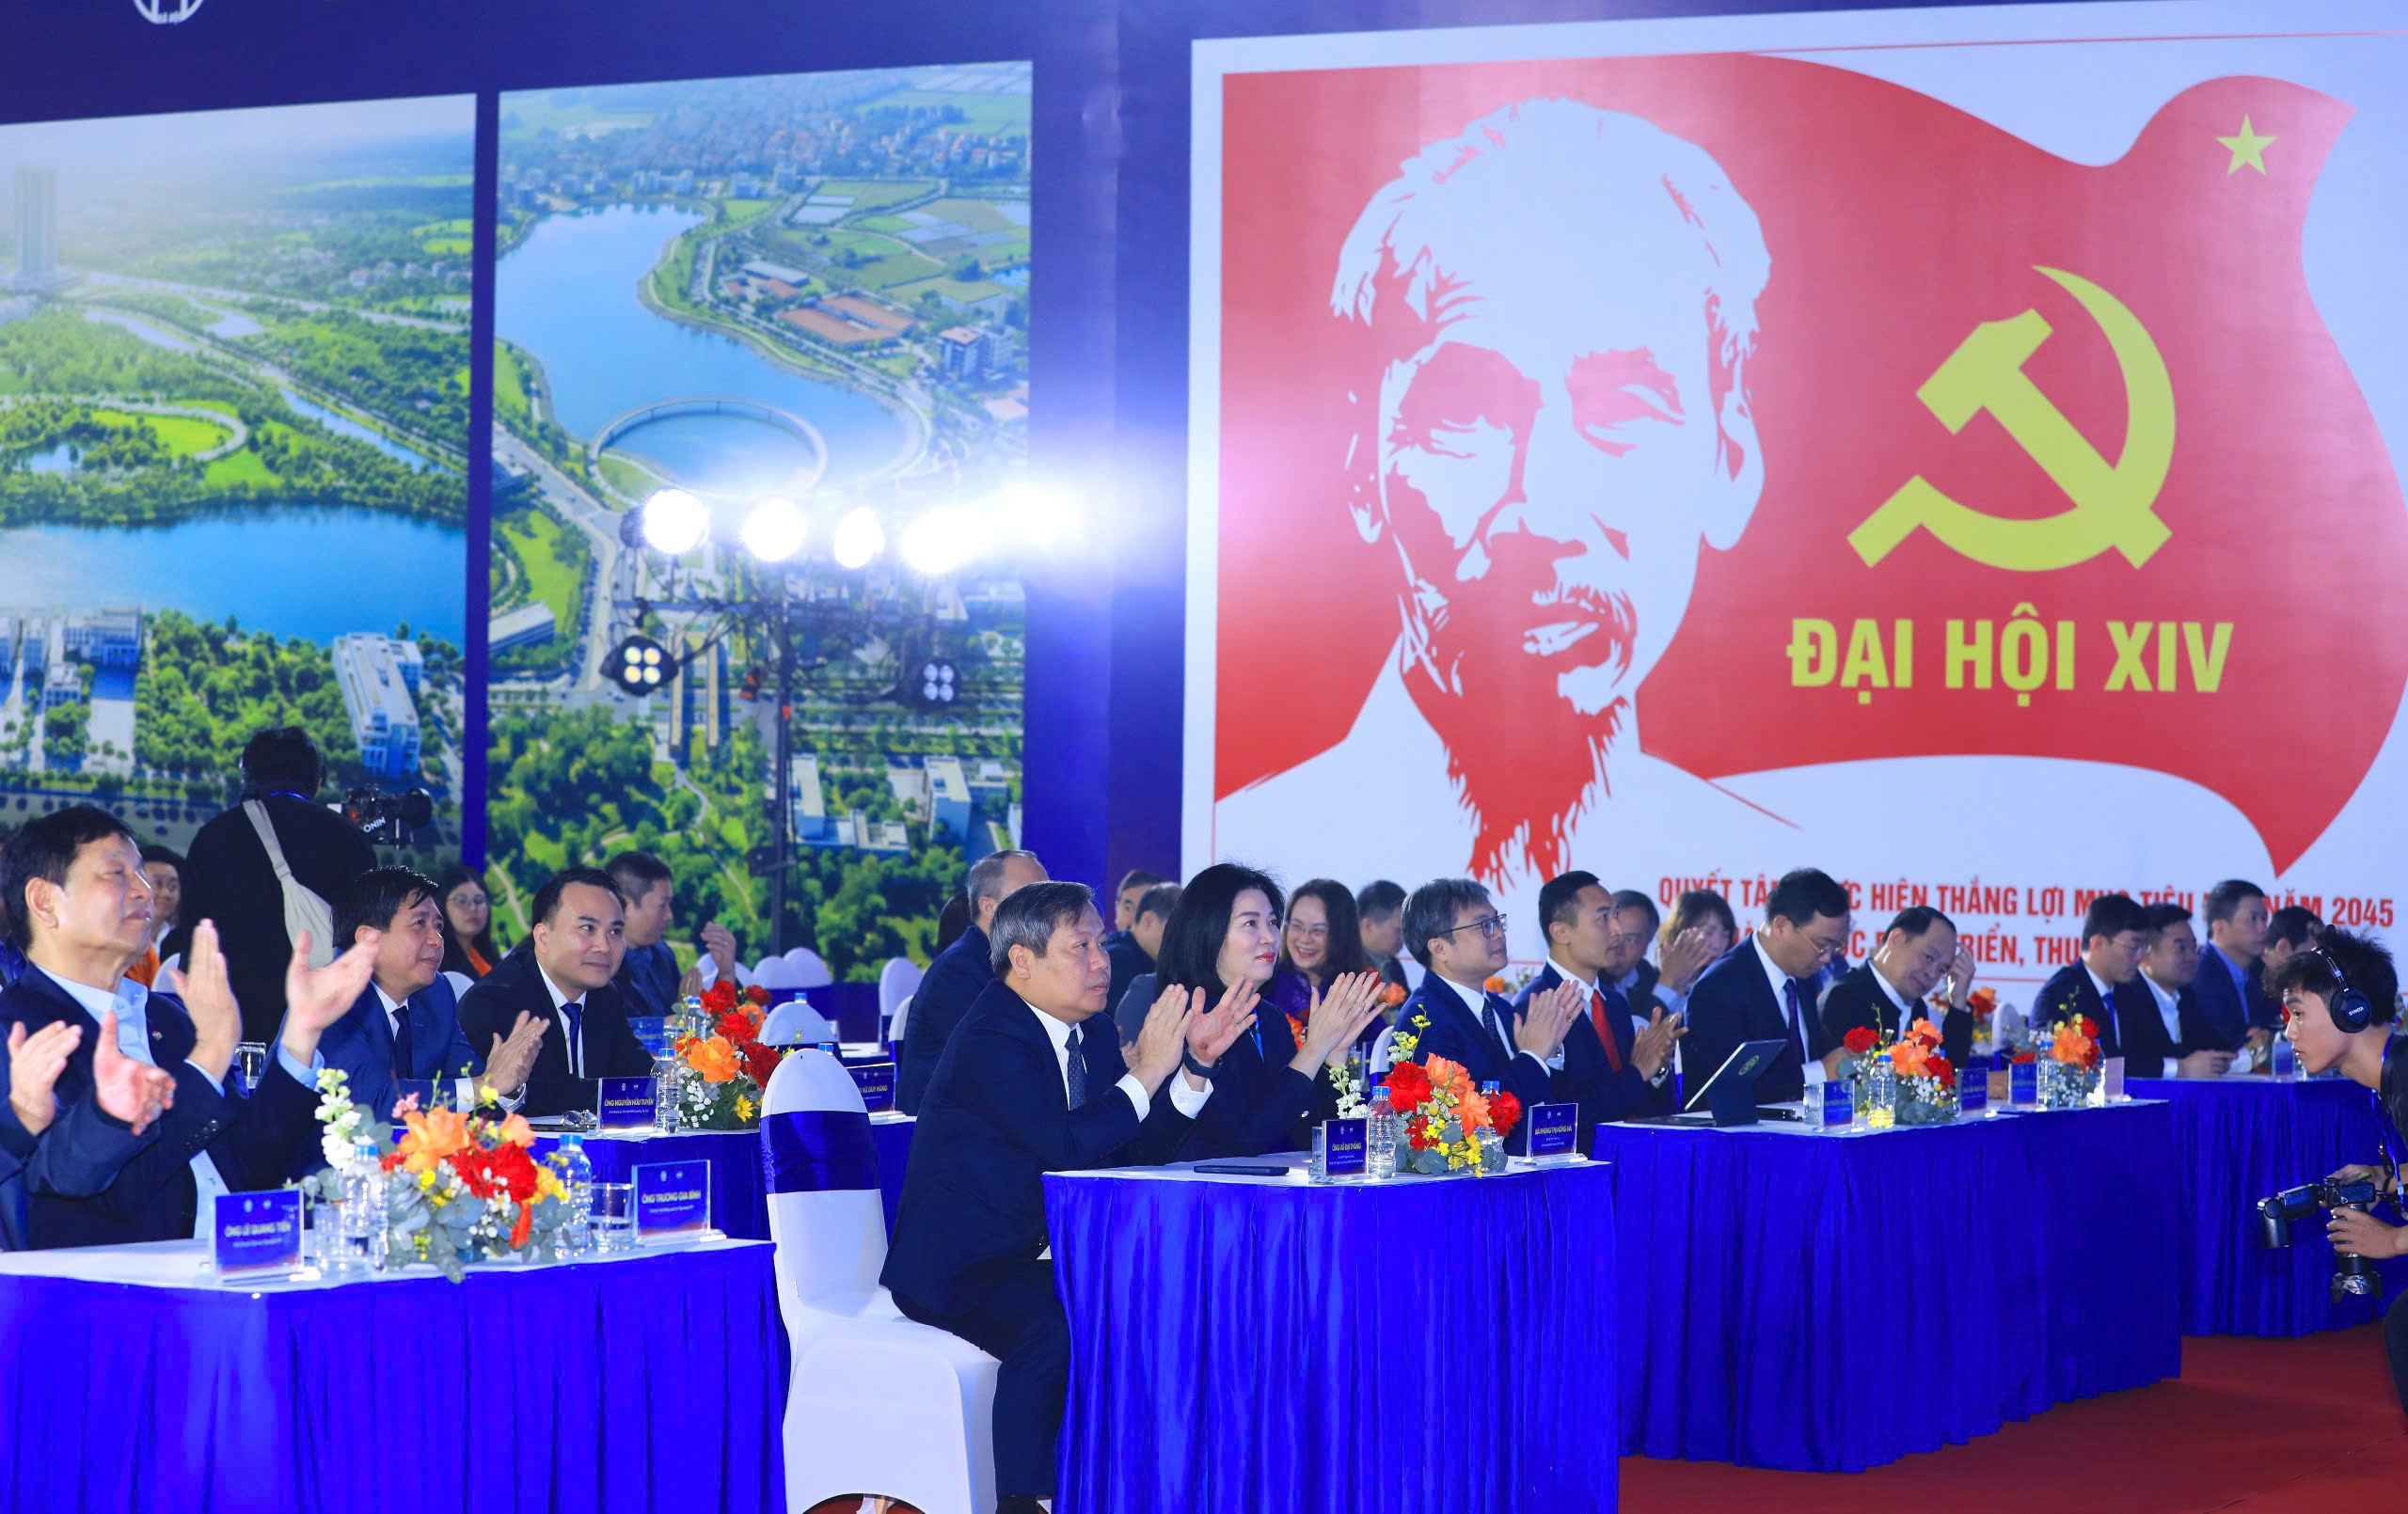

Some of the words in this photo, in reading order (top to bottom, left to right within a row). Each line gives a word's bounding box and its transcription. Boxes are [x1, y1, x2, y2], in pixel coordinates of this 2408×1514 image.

[1786, 617, 1914, 704] ĐẠI
[1944, 602, 2075, 707] HỘI
[2104, 621, 2234, 692] XIV
[1739, 873, 1780, 907] TÂ
[1936, 875, 2018, 916] THẮNG
[2027, 885, 2064, 923] LỢI
[2332, 897, 2394, 927] 2045
[1957, 922, 2025, 967] RIỂN,
